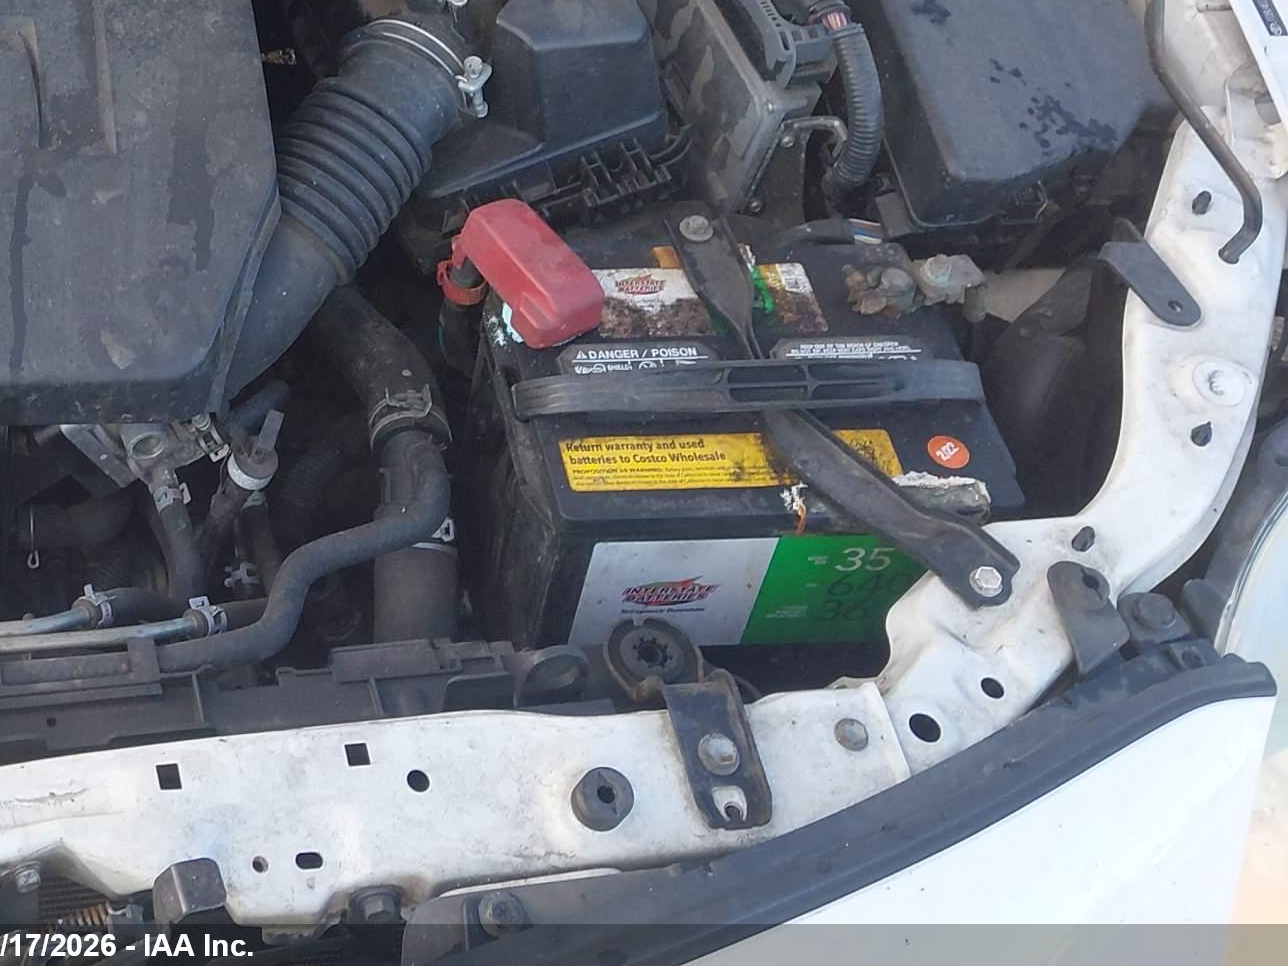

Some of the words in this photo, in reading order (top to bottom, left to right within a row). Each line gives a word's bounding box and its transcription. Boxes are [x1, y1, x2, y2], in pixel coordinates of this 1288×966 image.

[588, 349, 639, 359] DANGER
[651, 347, 697, 357] POISON
[566, 442, 602, 453] Return
[605, 441, 653, 452] warranty
[656, 440, 676, 450] and
[679, 439, 705, 449] used
[569, 455, 617, 465] batteries
[620, 454, 631, 464] to
[633, 453, 667, 463] Costco
[670, 451, 726, 462] Wholesale
[835, 547, 896, 571] 35
[622, 586, 720, 595] INTERSTATE
